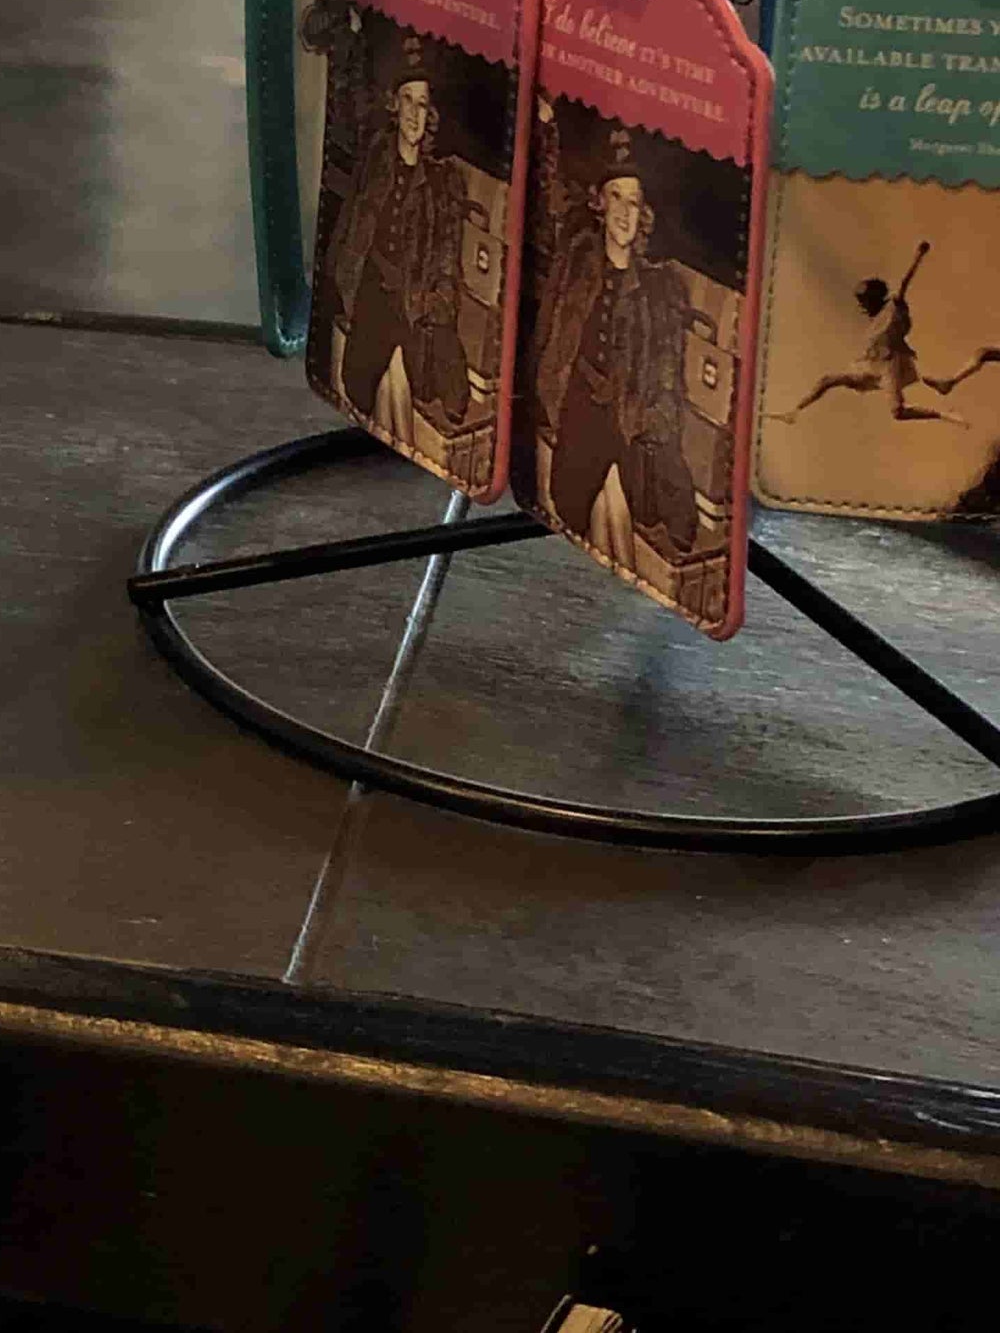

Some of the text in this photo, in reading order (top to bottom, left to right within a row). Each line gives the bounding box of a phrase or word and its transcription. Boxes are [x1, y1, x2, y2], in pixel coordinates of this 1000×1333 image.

[578, 8, 637, 59] believe
[800, 45, 935, 70] AVAILABLE
[858, 85, 882, 110] is
[888, 94, 906, 112] a
[914, 82, 972, 124] leap
